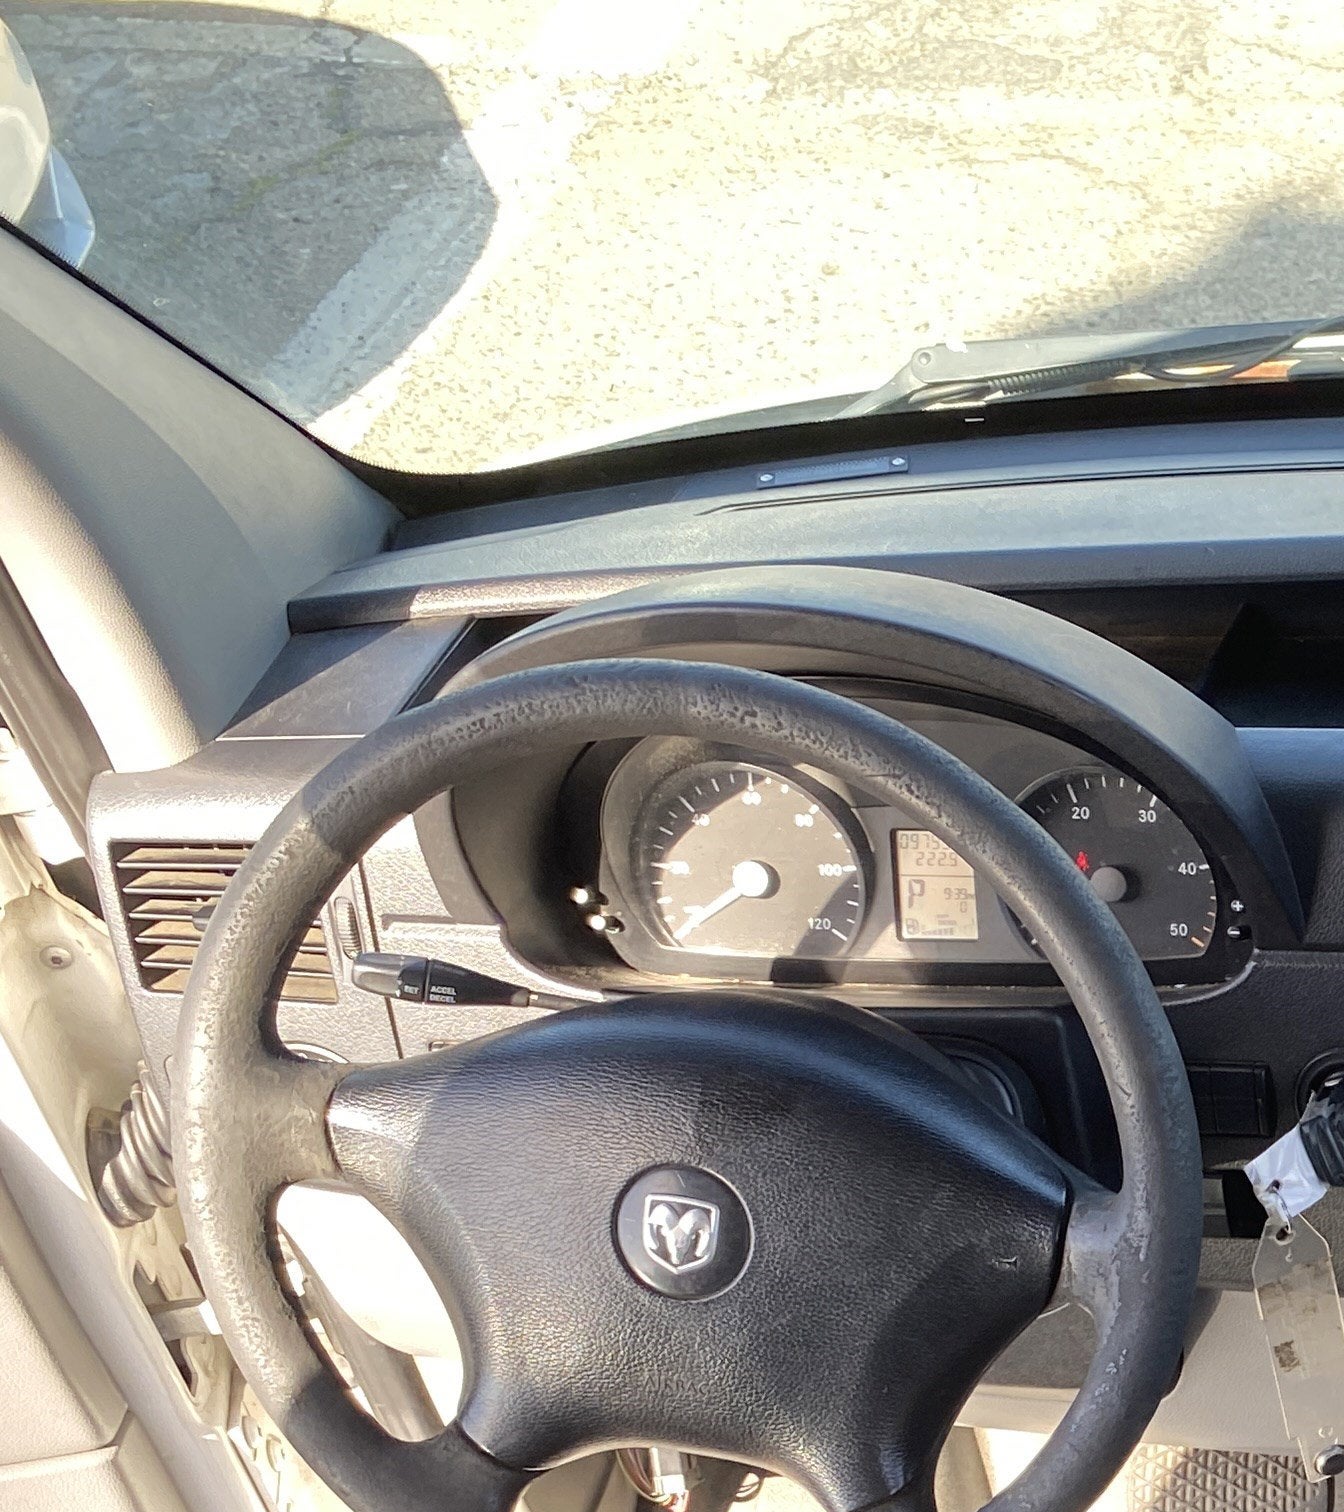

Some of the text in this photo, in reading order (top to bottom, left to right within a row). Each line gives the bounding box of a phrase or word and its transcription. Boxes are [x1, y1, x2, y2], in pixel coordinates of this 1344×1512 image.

[1071, 806, 1091, 820] 20
[1138, 809, 1157, 823] 30
[817, 863, 843, 877] 100
[1177, 861, 1197, 876] 40
[807, 916, 832, 931] 120
[1169, 923, 1188, 937] 50
[430, 985, 456, 995] ACCEL
